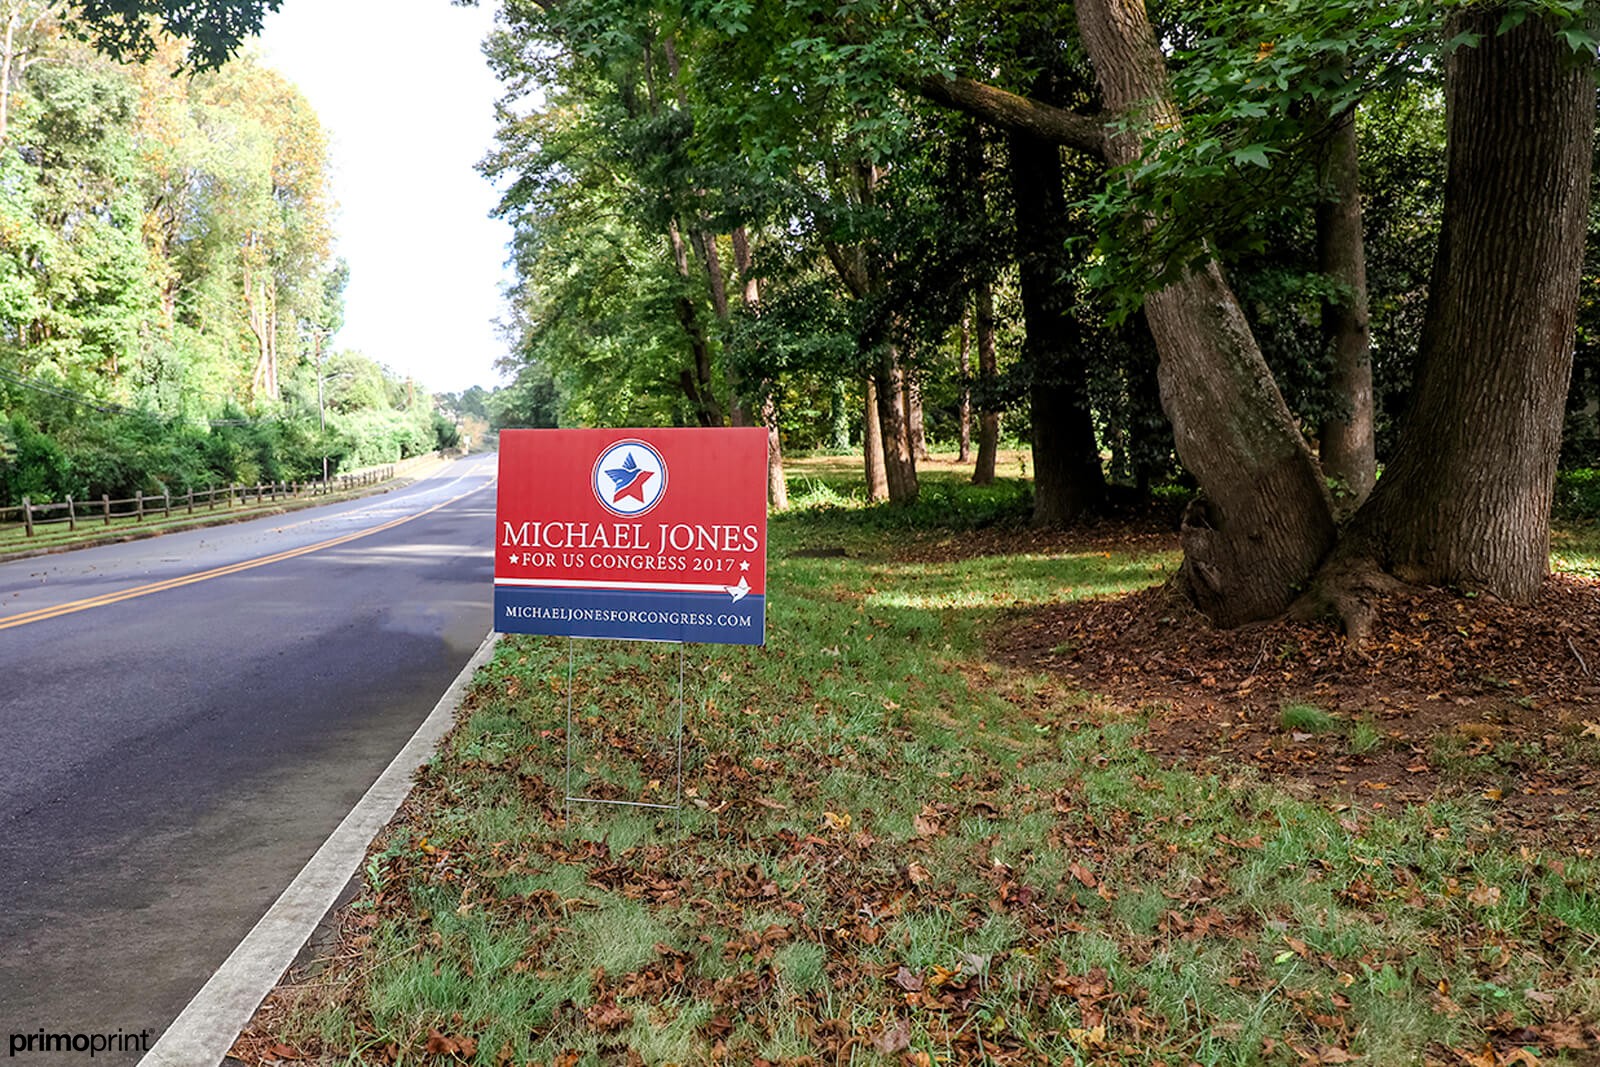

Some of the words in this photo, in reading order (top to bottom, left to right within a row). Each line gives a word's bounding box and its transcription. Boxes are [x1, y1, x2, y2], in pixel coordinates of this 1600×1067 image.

[502, 521, 650, 550] MICHAEL
[657, 523, 759, 555] JONES
[521, 552, 556, 568] FOR
[563, 553, 584, 568] US
[590, 554, 687, 571] CONGRESS
[693, 558, 735, 572] 2017
[505, 606, 752, 627] MICHAELJONESFORCONGRESS.COM
